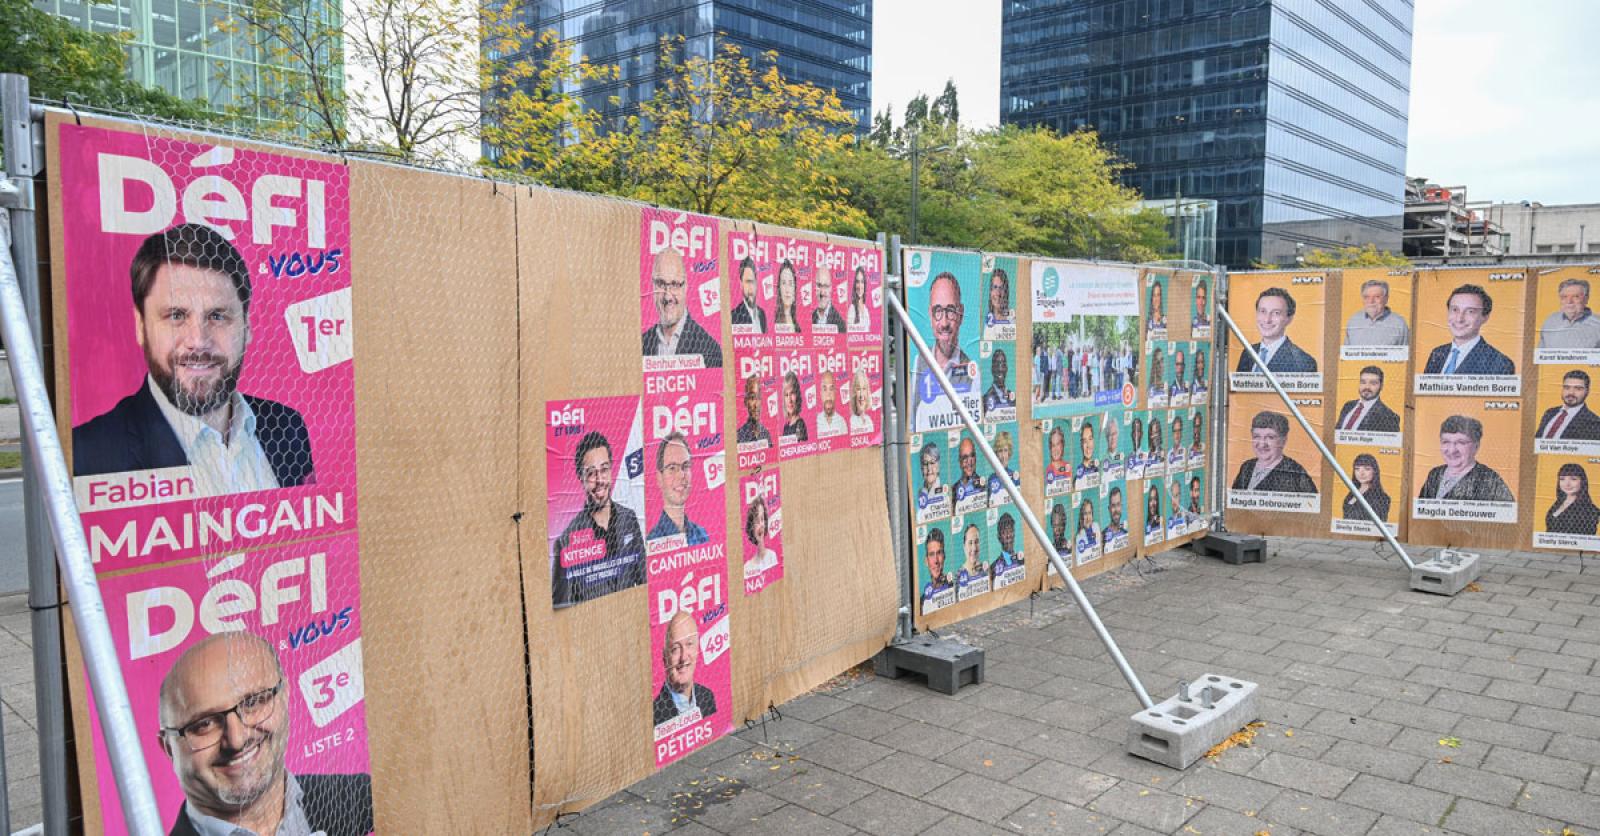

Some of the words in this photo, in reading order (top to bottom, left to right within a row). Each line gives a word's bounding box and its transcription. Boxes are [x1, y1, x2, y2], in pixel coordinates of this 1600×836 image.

[300, 315, 346, 353] 1er
[646, 374, 697, 395] ERGEN
[924, 372, 931, 399] 1
[1232, 380, 1264, 389] Mathias
[1297, 381, 1320, 390] Borre
[1419, 383, 1454, 392] Mathias
[1456, 384, 1489, 393] Vanden
[1491, 384, 1517, 394] Borre
[739, 452, 767, 468] DIALO
[88, 474, 194, 506] Fabian
[1230, 497, 1257, 508] Magda
[1258, 498, 1302, 509] Debrouwer
[1417, 506, 1446, 517] Magda
[1448, 507, 1497, 519] Debrouwer
[91, 491, 344, 563] MAINGAIN
[649, 543, 724, 575] CANTINIAUX
[312, 671, 350, 710] 3e
[655, 711, 701, 738] Jean-Louis
[303, 732, 344, 758] LISTE
[344, 727, 355, 744] 2
[657, 720, 713, 762] PÉTERS
